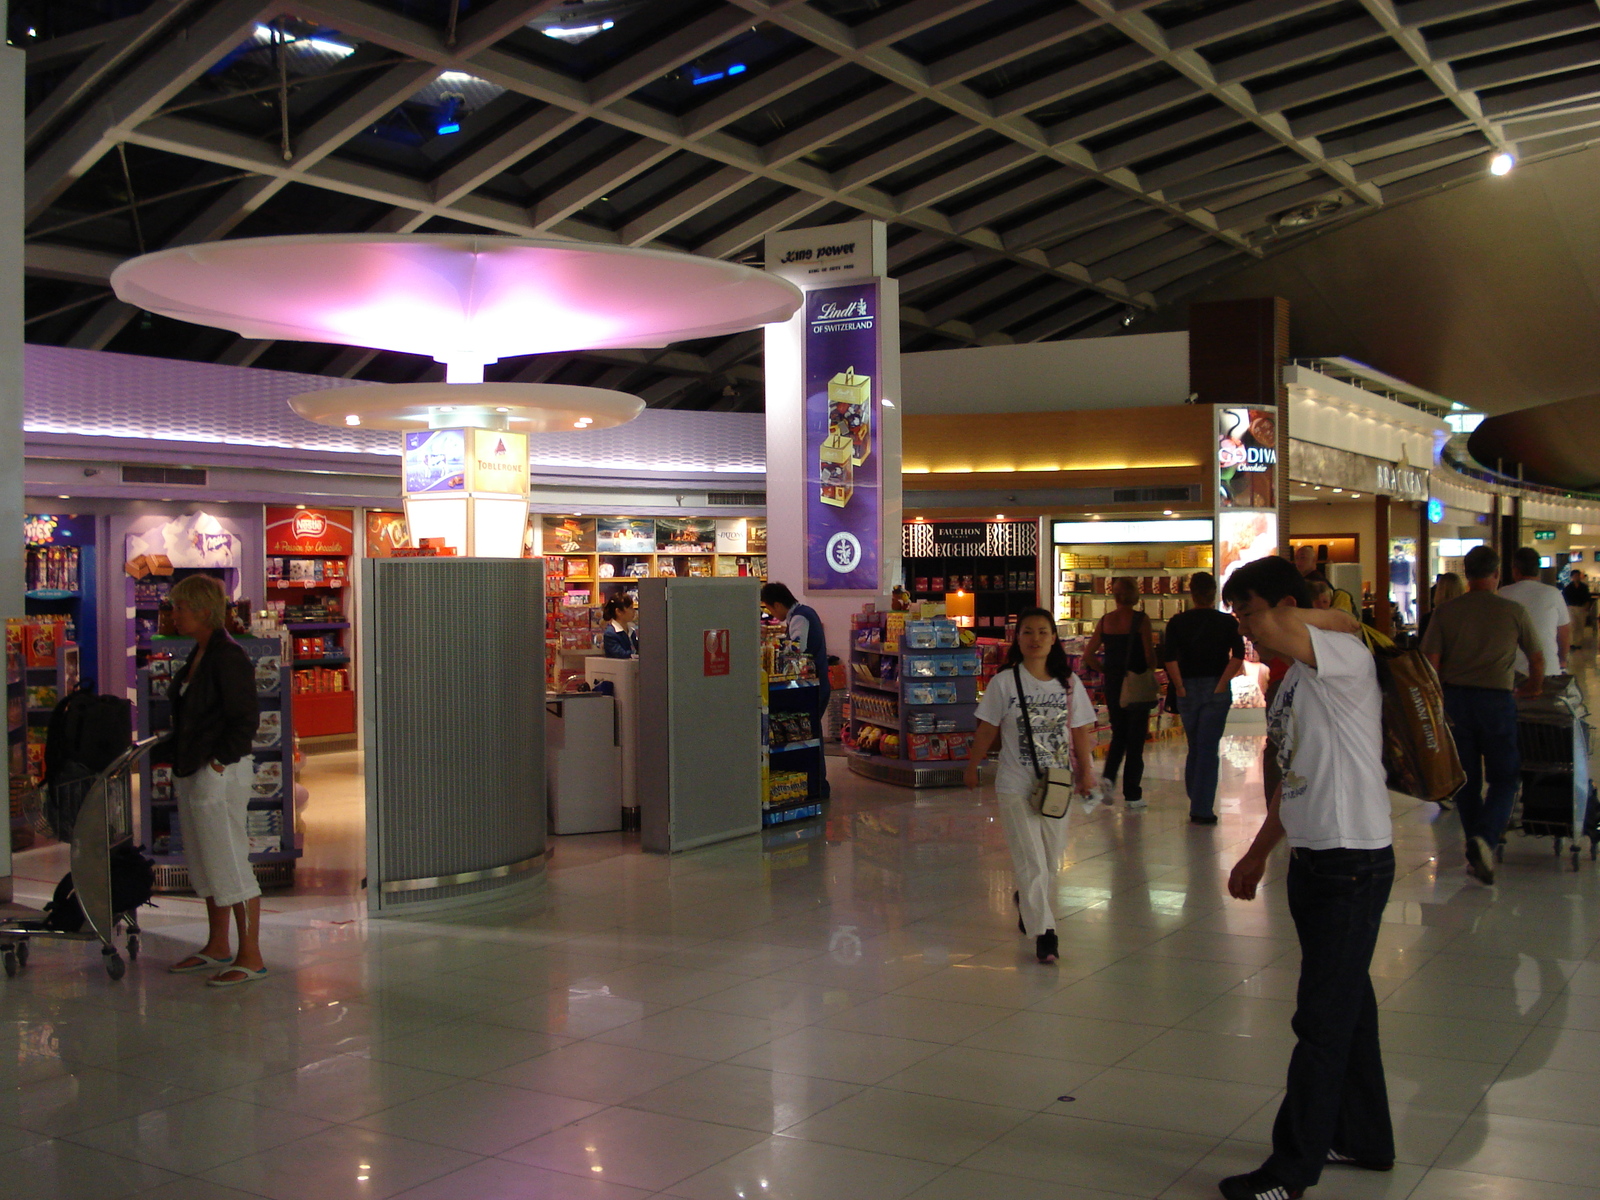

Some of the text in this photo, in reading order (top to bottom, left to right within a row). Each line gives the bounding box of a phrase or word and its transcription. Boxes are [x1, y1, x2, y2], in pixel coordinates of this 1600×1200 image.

[817, 302, 858, 320] Lindt
[813, 320, 873, 334] OF SWITZERLAND
[1218, 446, 1277, 464] GODIVA
[477, 459, 523, 472] TOBLERONE
[939, 528, 981, 536] FAUCHON
